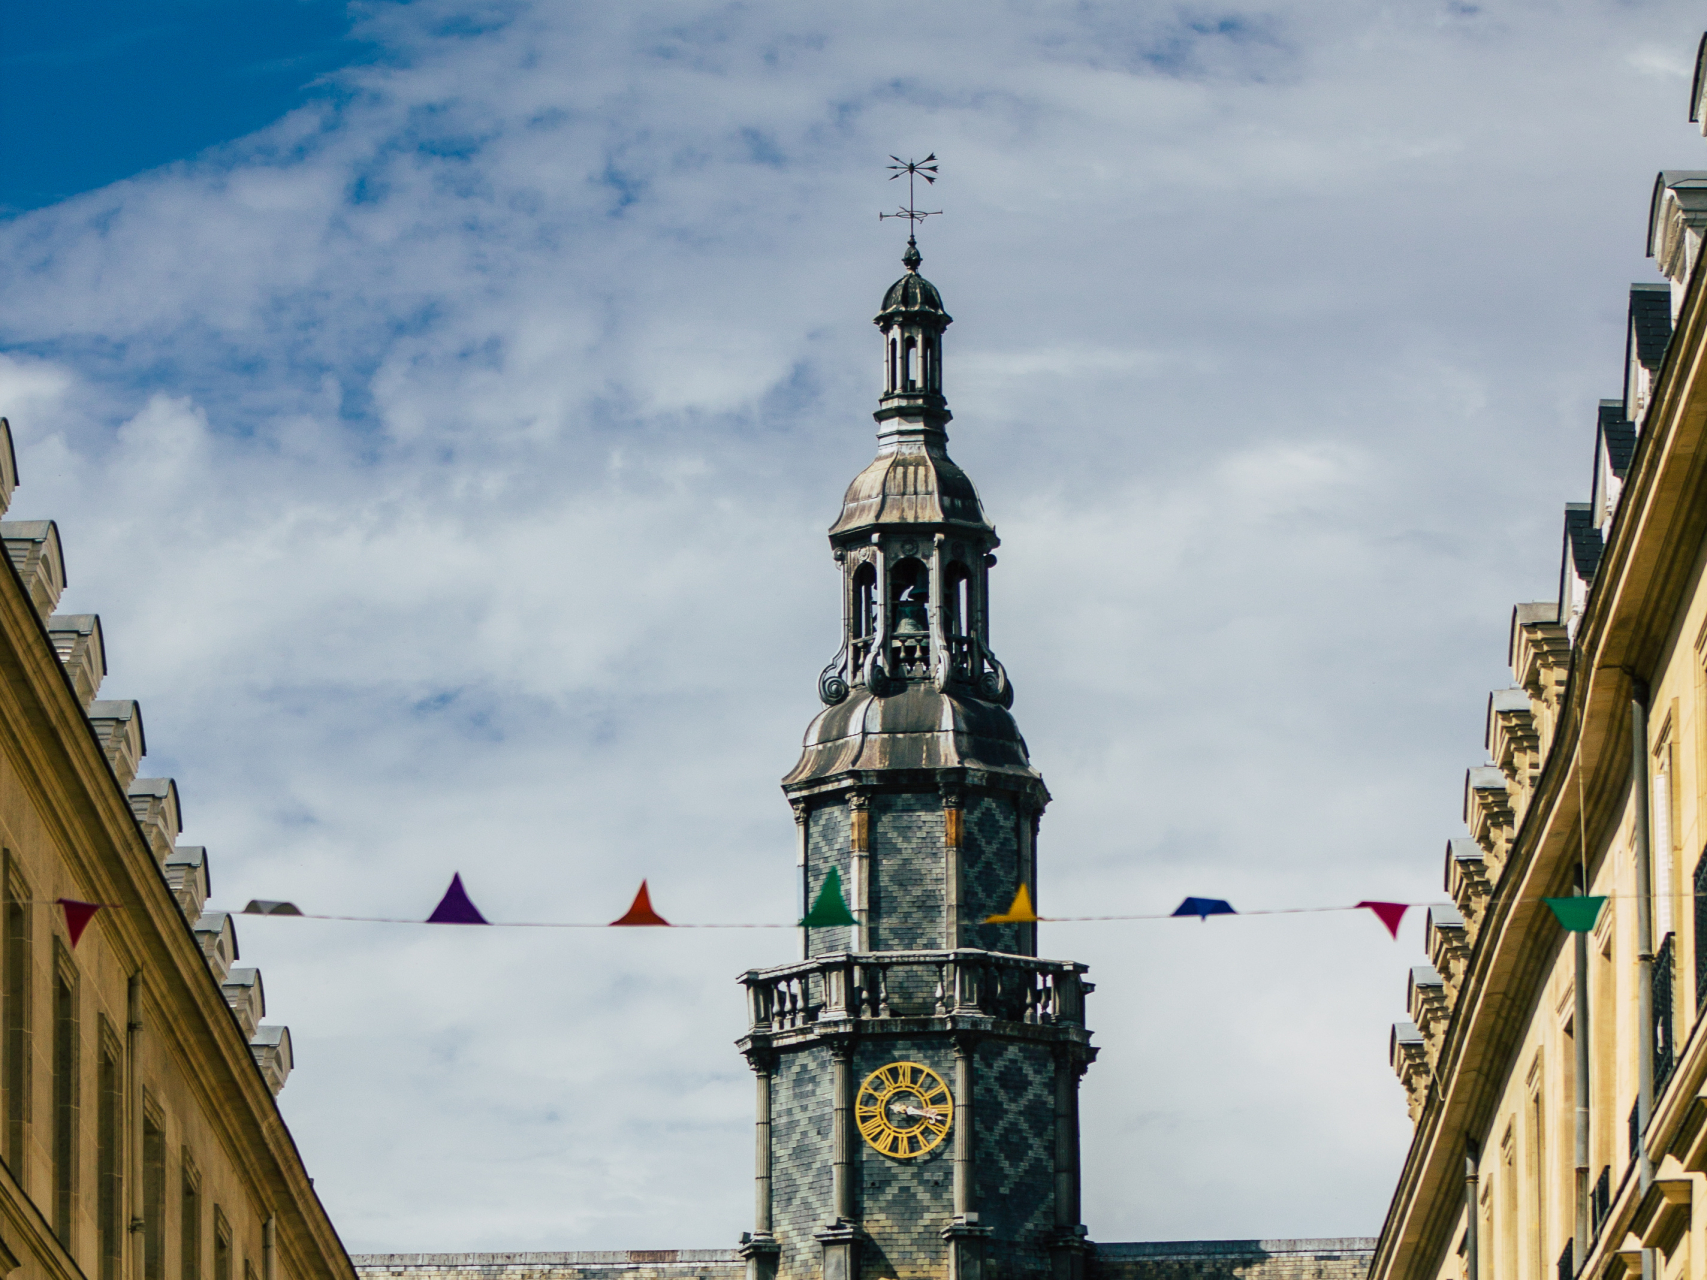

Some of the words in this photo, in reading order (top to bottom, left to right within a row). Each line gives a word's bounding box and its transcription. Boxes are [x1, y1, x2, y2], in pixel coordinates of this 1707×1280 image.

[877, 1068, 895, 1090] XI
[897, 1065, 911, 1085] XII
[863, 1084, 882, 1100] X
[924, 1083, 945, 1099] II
